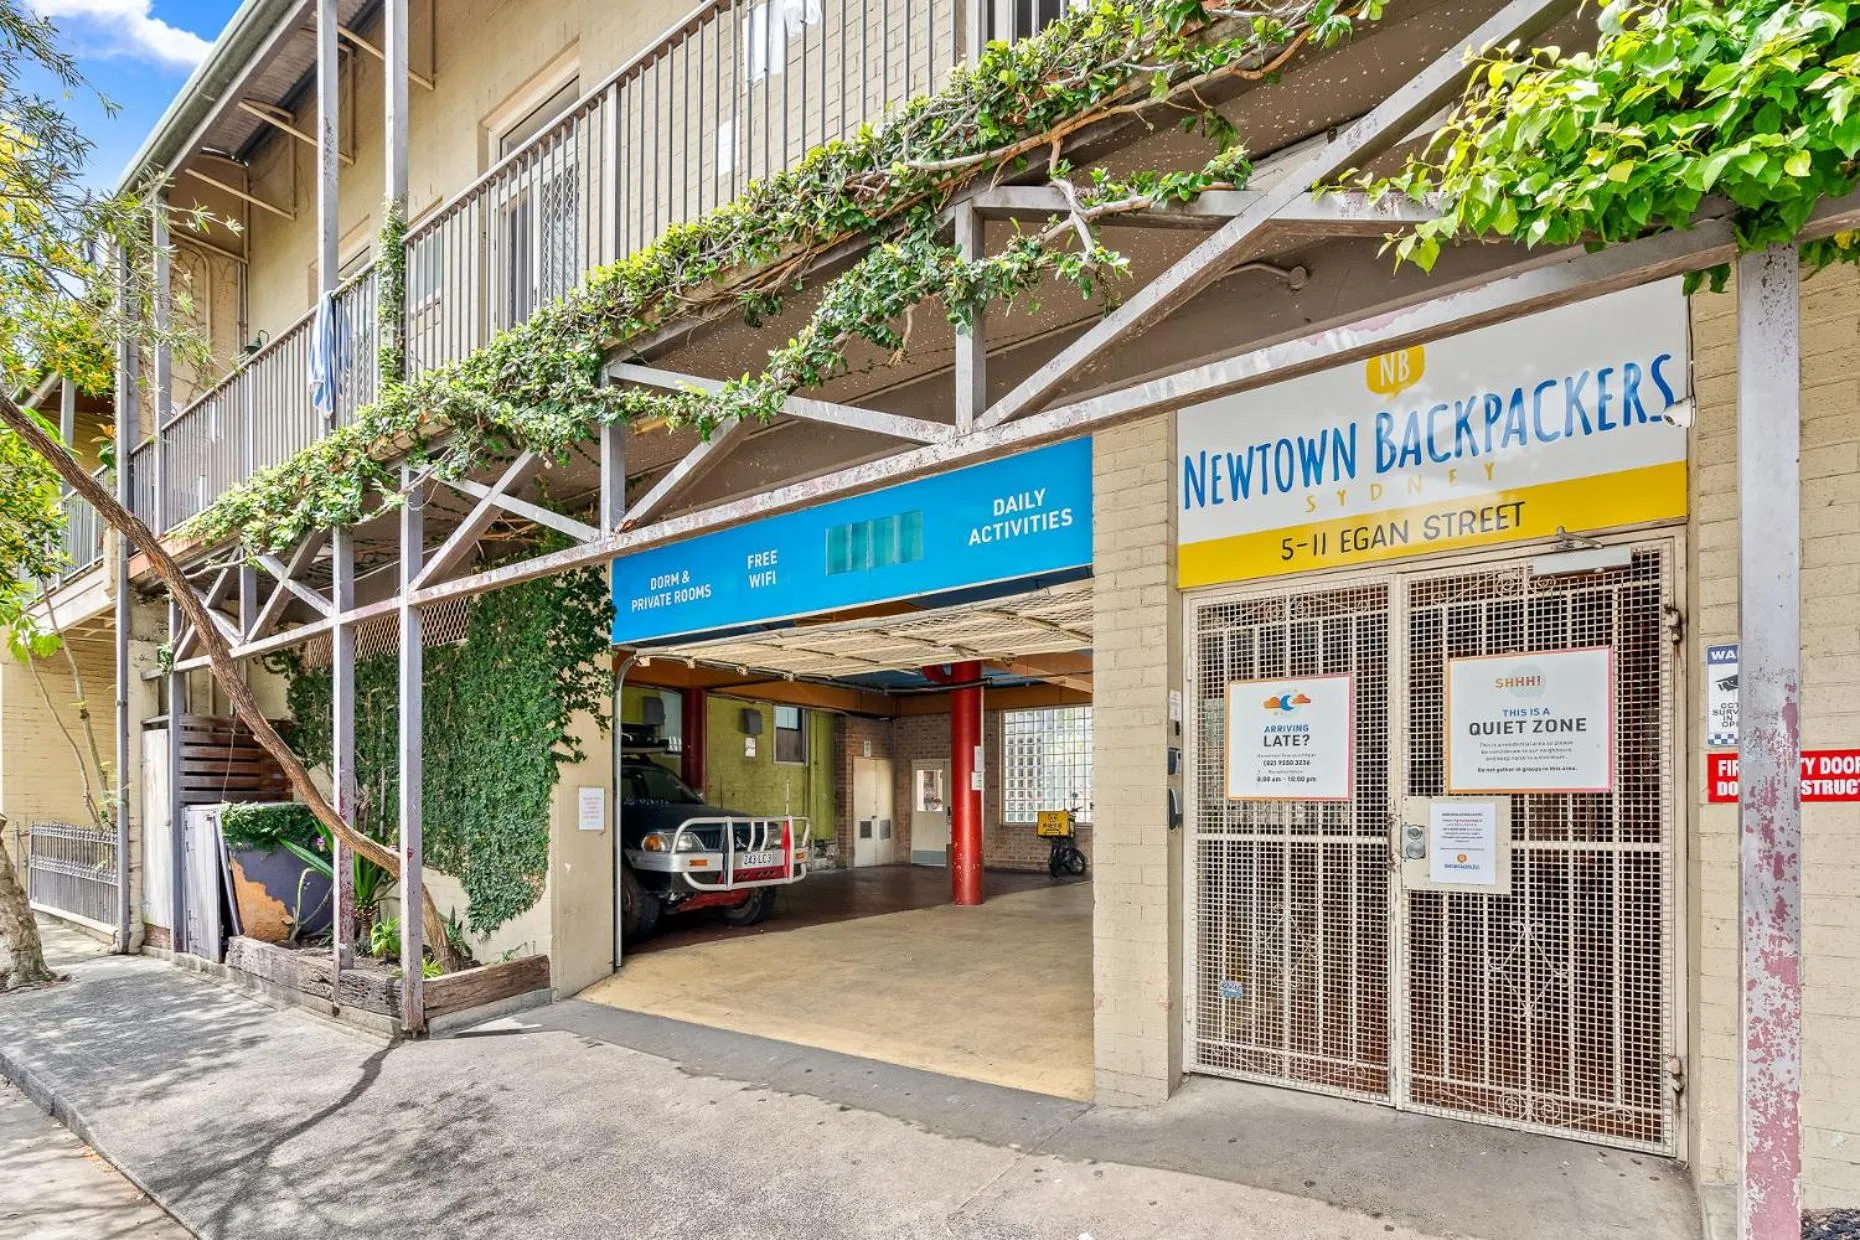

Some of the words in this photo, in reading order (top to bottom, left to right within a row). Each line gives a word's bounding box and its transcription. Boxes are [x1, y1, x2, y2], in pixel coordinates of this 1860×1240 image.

[1380, 350, 1410, 386] NB
[1184, 422, 1357, 510] NEWTOWN
[1375, 353, 1676, 474] BACKPACKERS
[1305, 462, 1496, 513] SYDNEY
[992, 488, 1047, 517] DAILY
[968, 508, 1074, 546] ACTIVITIES
[1281, 534, 1328, 561] 5-11
[1340, 519, 1410, 552] EGAN
[1423, 501, 1527, 540] STREET
[747, 550, 778, 570] FREE
[649, 573, 680, 592] DORM
[681, 571, 691, 584] &
[749, 571, 777, 589] WIFI
[631, 592, 673, 613] PRIVATE
[674, 583, 712, 604] ROOMS
[1711, 650, 1737, 660] WA
[1495, 675, 1542, 689] SHHH!
[1503, 708, 1528, 718] THIS
[1529, 708, 1541, 717] IS
[1542, 707, 1551, 716] A
[1264, 724, 1309, 733] ARRIVING
[1468, 719, 1528, 737] QUIET
[1532, 717, 1587, 734] ZONE
[1263, 734, 1310, 747] LATE?
[1718, 759, 1740, 777] FIR
[1801, 778, 1860, 796] STRUC
